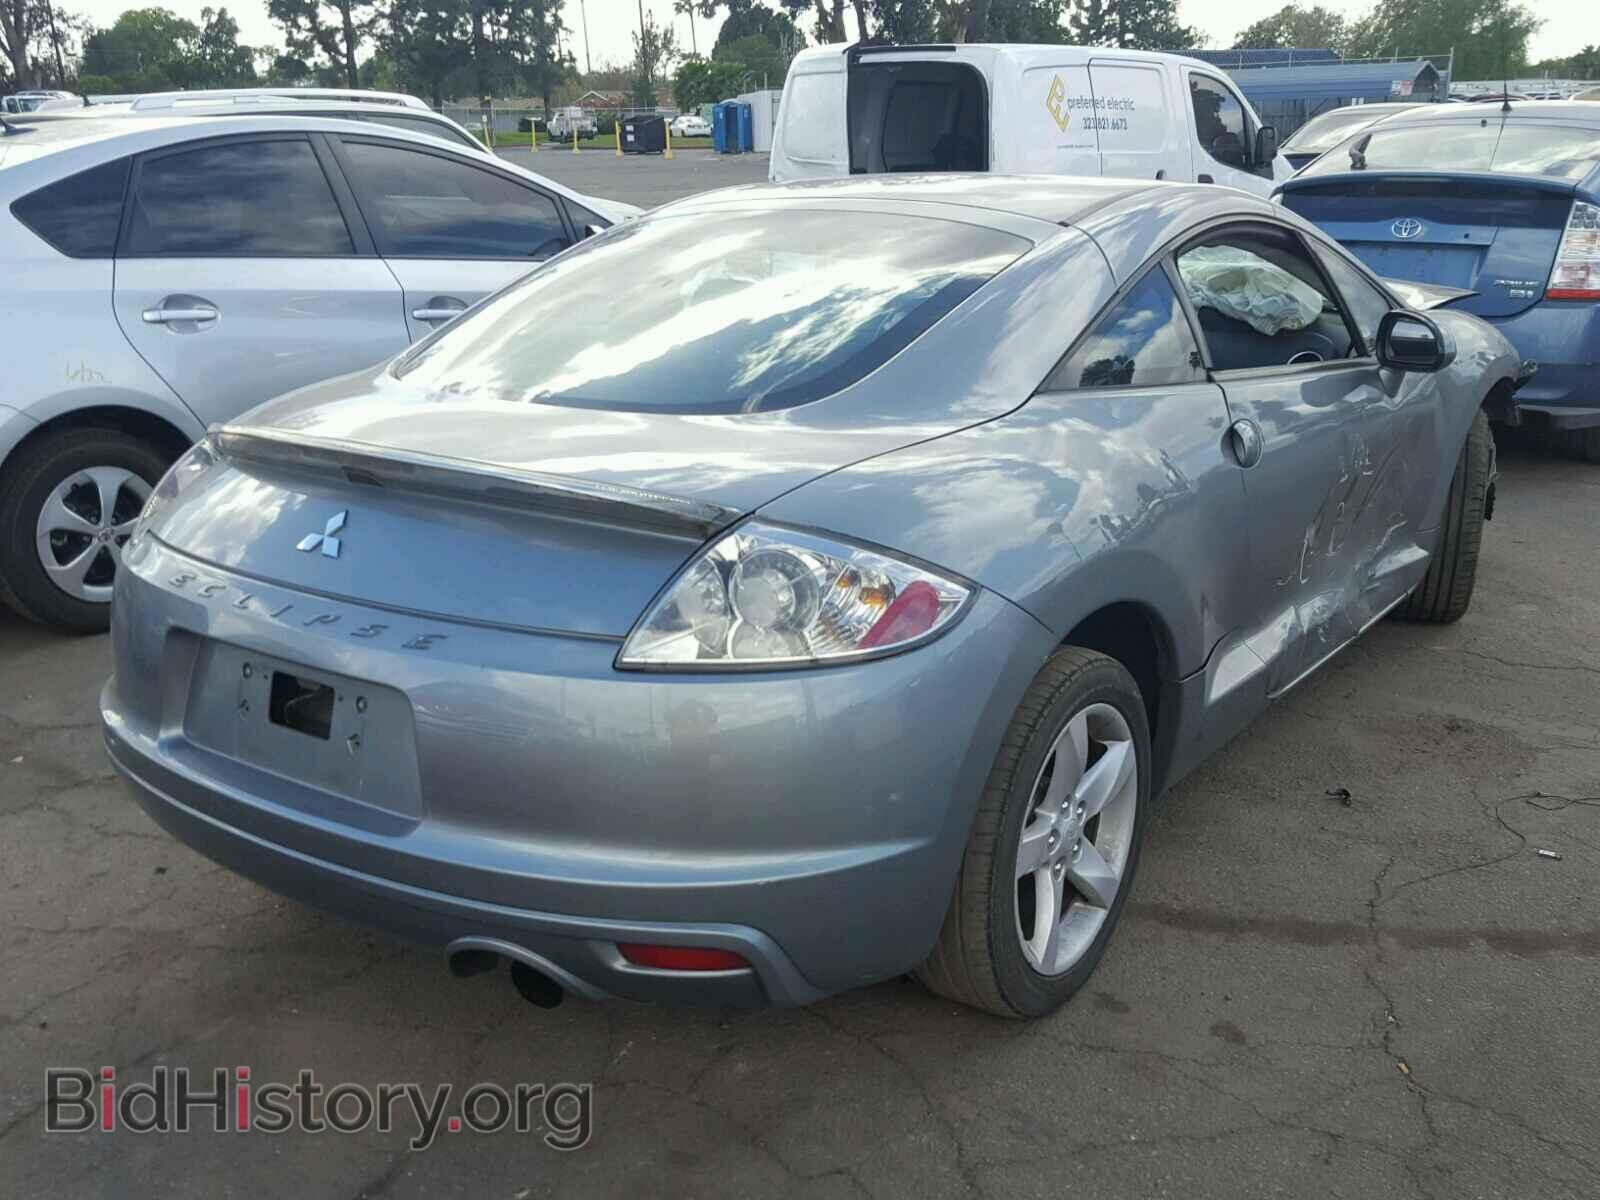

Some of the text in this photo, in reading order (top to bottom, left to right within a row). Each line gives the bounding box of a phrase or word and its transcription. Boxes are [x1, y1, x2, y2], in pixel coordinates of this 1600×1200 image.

[1067, 95, 1136, 112] preferred electric
[1082, 117, 1096, 130] 323
[1097, 117, 1110, 130] 821
[168, 572, 448, 650] ECLIPSE
